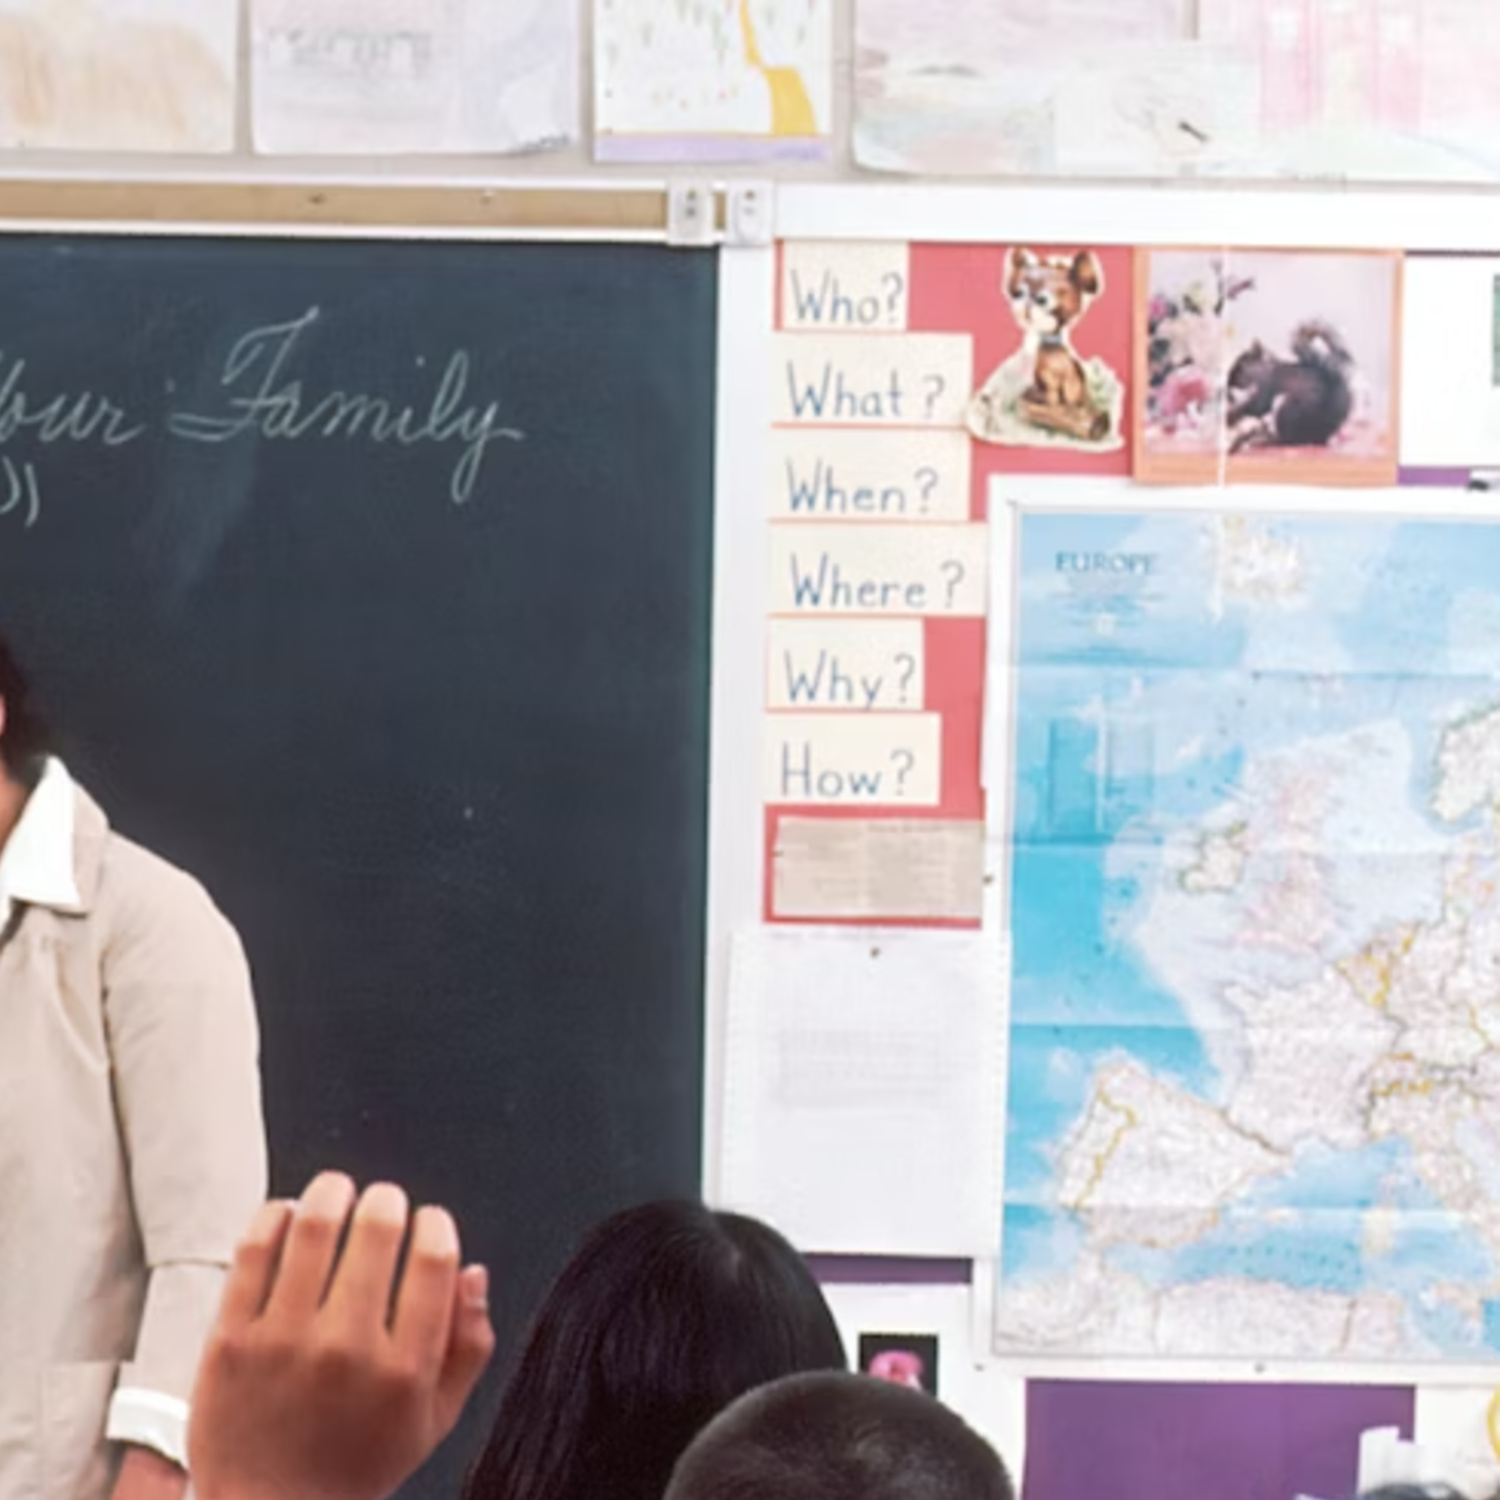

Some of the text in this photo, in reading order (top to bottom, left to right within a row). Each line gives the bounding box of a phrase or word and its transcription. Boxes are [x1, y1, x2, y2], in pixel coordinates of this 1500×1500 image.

[789, 267, 904, 326] Who?
[170, 305, 526, 505] Family
[1055, 551, 1158, 575] EUROPE
